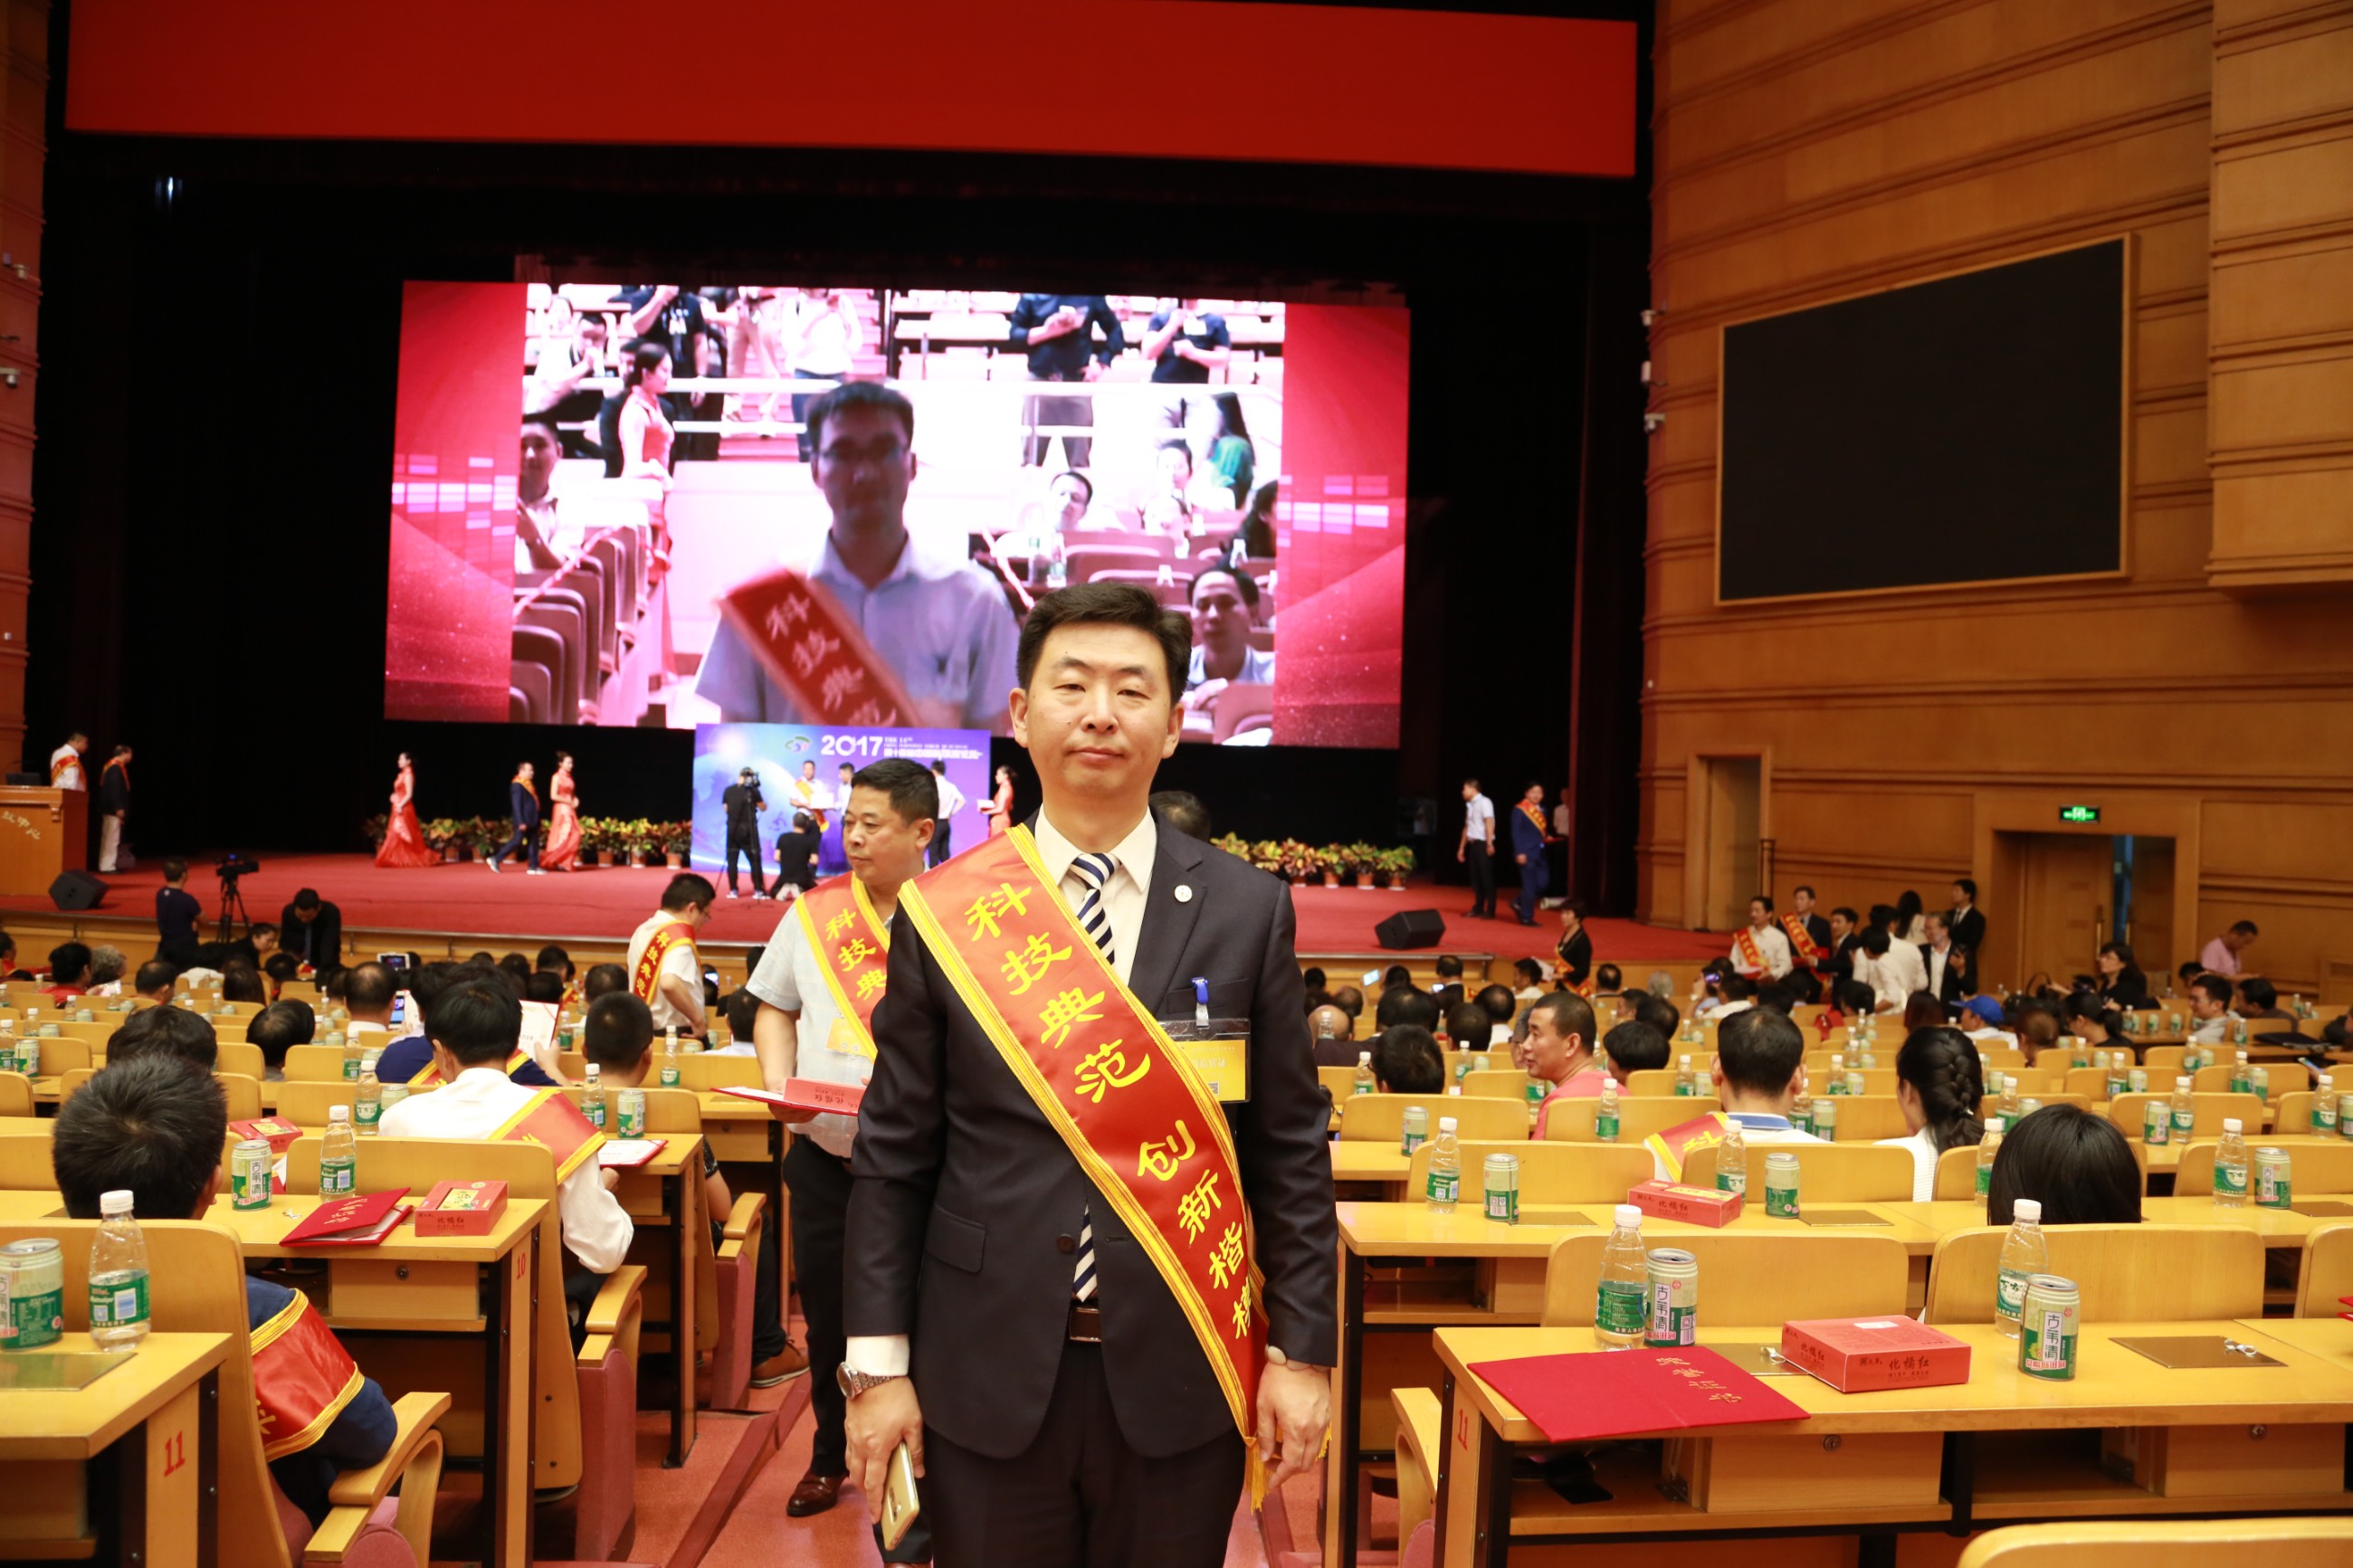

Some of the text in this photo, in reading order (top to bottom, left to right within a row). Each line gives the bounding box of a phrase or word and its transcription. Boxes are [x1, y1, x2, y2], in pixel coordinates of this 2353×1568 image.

[821, 735, 883, 756] 2017
[966, 881, 1152, 1104] 科技典范
[516, 1252, 526, 1280] 10
[1889, 1355, 1930, 1371] 化橘红
[1457, 1409, 1469, 1452] 11
[164, 1430, 186, 1478] 11
